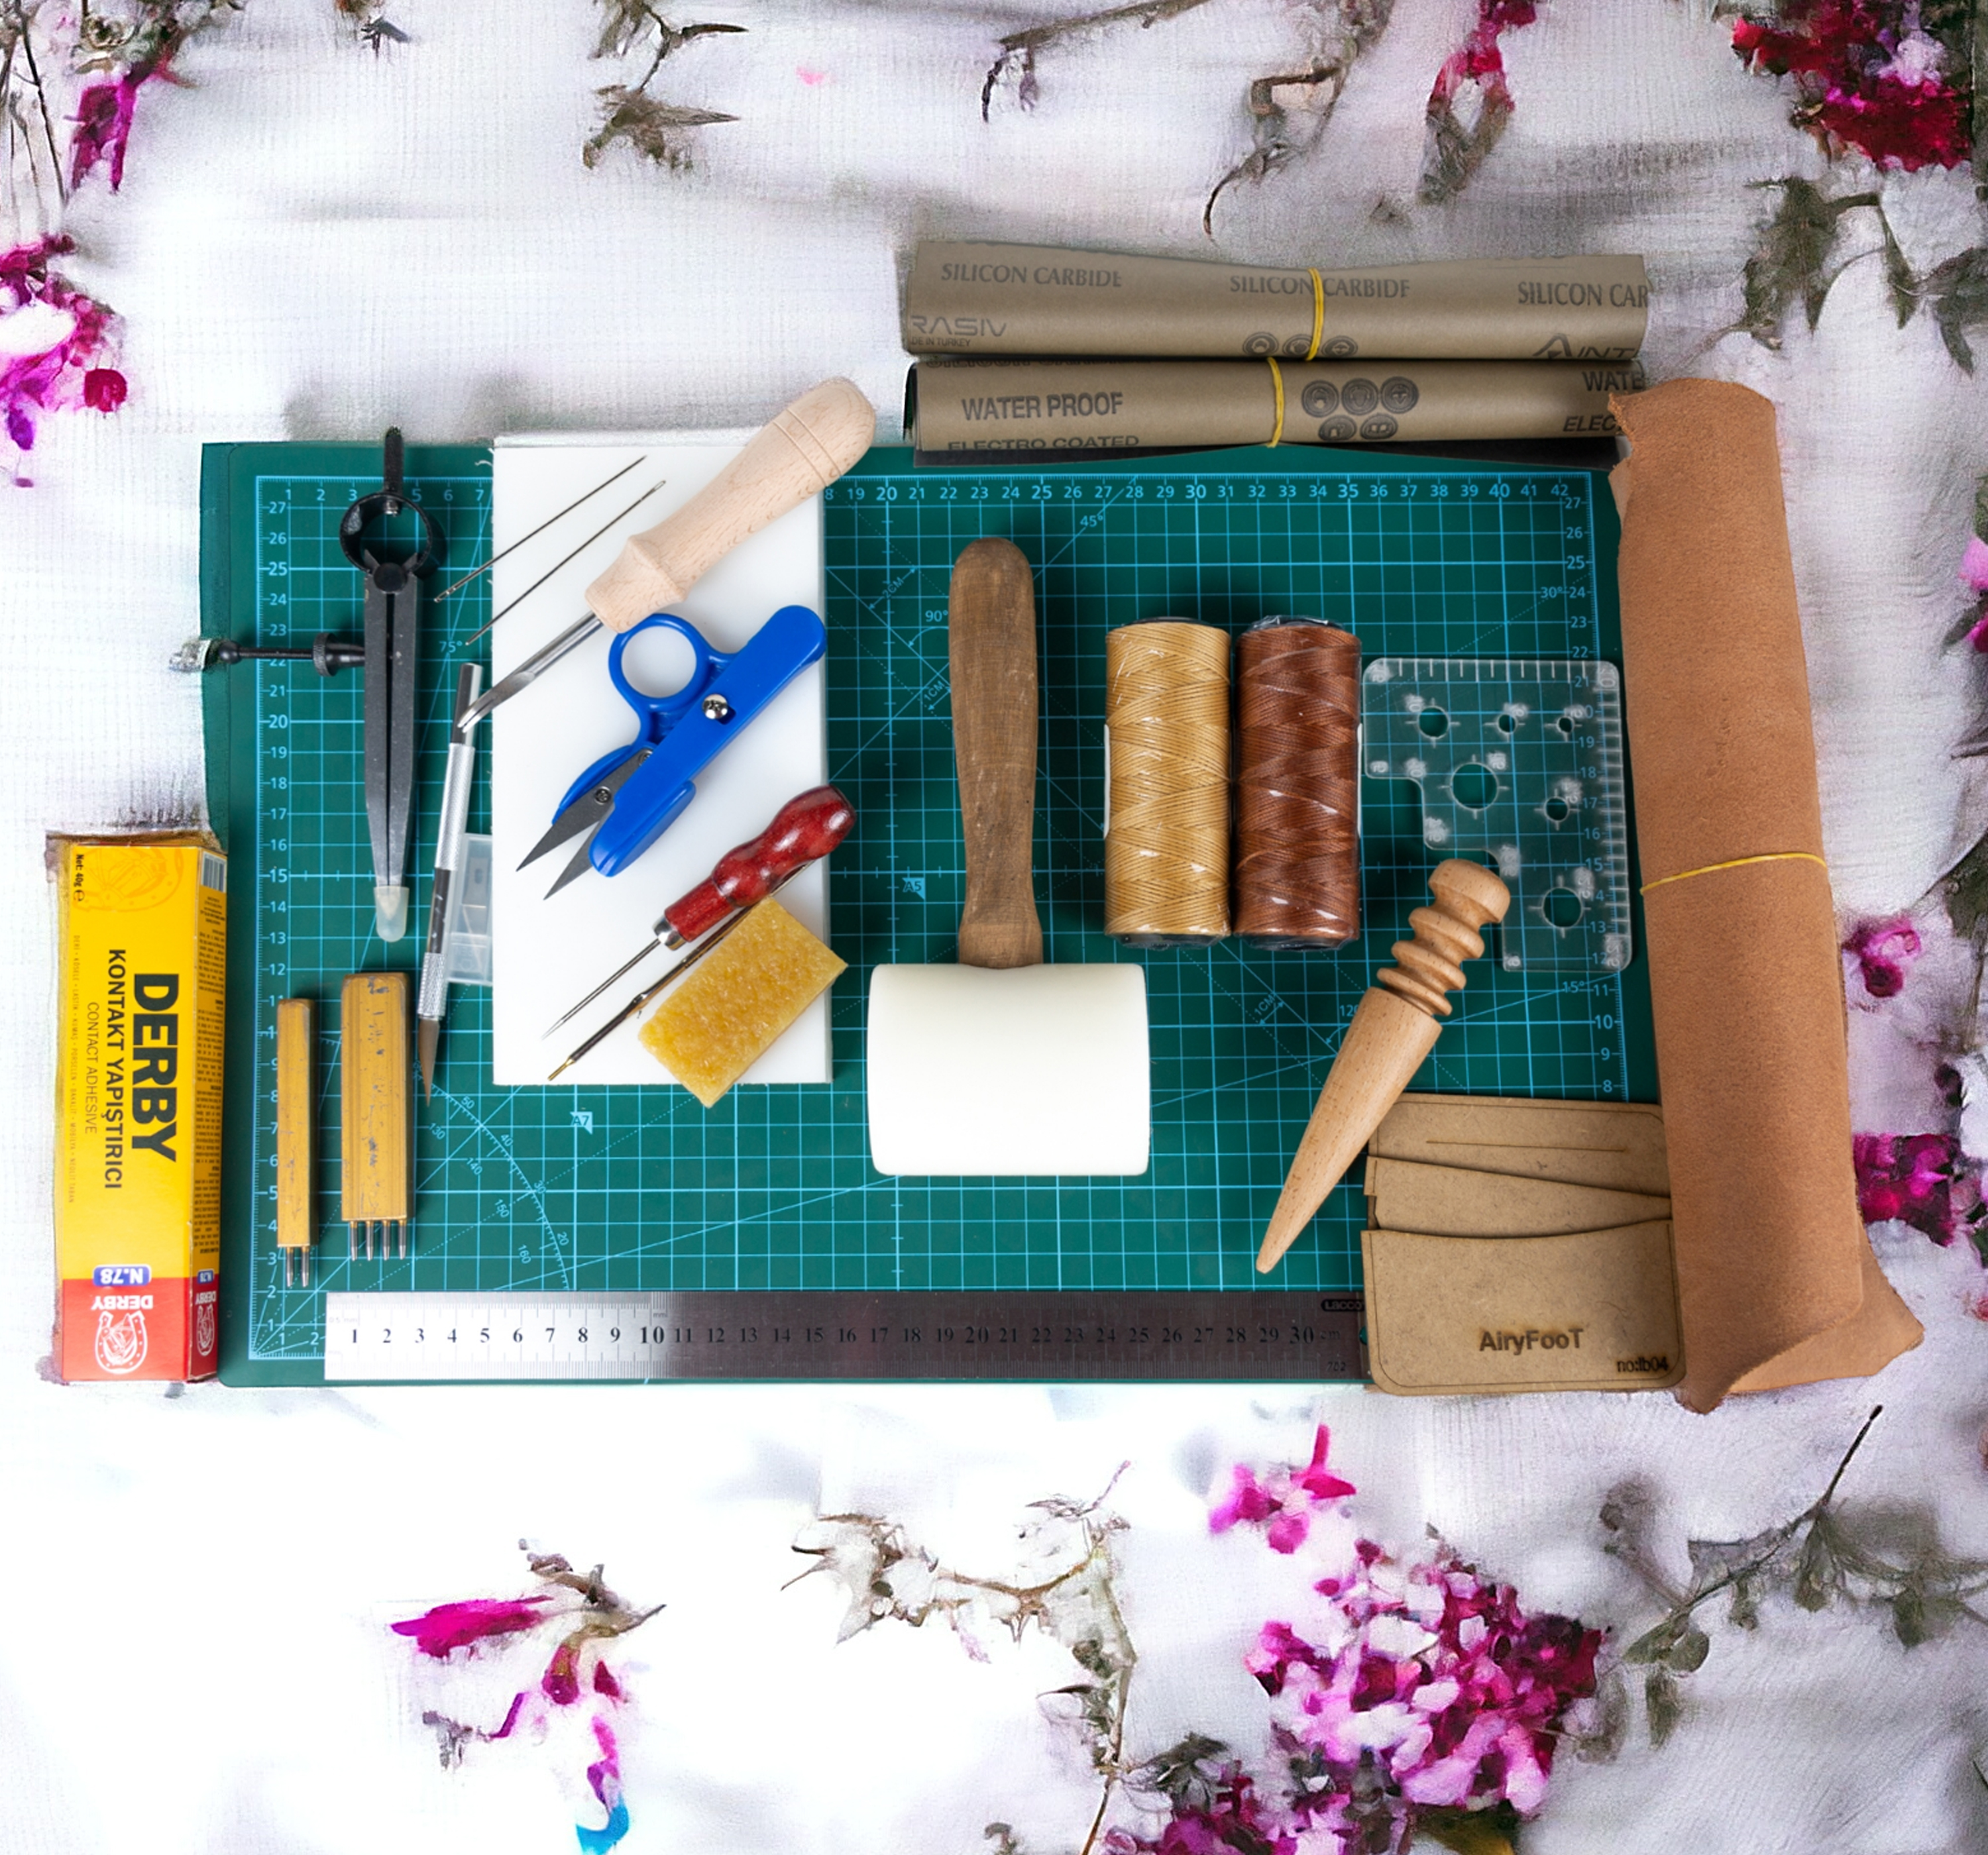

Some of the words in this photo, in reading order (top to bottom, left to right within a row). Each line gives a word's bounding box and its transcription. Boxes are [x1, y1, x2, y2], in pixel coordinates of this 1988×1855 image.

[941, 262, 1026, 284] SILICON
[1034, 266, 1122, 288] CARBIDE
[1230, 274, 1314, 295] SILICON
[1324, 276, 1410, 298] CARBIDE
[1518, 280, 1602, 307] SILICON
[937, 337, 971, 346] TURKEY
[961, 395, 1042, 421] WATER
[1046, 392, 1123, 417] PROOF
[1563, 413, 1620, 432] ELEC
[947, 438, 1046, 450] ELECTRO
[1052, 435, 1140, 449] COATED
[285, 489, 292, 500] 1
[317, 489, 325, 501] 2
[349, 489, 358, 501] 3
[412, 489, 421, 502] 5
[444, 489, 453, 502] 6
[476, 489, 484, 502] 7
[848, 488, 865, 500] 19
[876, 486, 898, 501] 20
[909, 487, 925, 500] 21
[940, 487, 958, 500] 22
[971, 486, 989, 499] 23
[1002, 486, 1020, 499] 24
[1032, 484, 1052, 500] 25
[1064, 486, 1082, 498] 26
[1095, 486, 1113, 498] 27
[1126, 486, 1144, 498] 28
[1156, 486, 1175, 498] 29
[1185, 484, 1207, 499] 30
[1217, 485, 1235, 498] 31
[1248, 485, 1266, 498] 32
[1278, 485, 1296, 498] 33
[1309, 485, 1327, 498] 34
[1338, 484, 1358, 498] 35
[1370, 485, 1388, 498] 36
[1400, 485, 1417, 498] 37
[1430, 485, 1449, 498] 38
[1461, 484, 1478, 497] 39
[1489, 483, 1510, 498] 40
[1520, 484, 1537, 497] 41
[1551, 484, 1569, 497] 42
[269, 502, 286, 514] 27
[1565, 497, 1581, 509] 27
[269, 532, 287, 545] 26
[1566, 527, 1583, 539] 26
[268, 562, 288, 576] 25
[1567, 555, 1585, 570] 25
[1569, 586, 1586, 599] 24
[269, 594, 287, 606] 24
[1571, 615, 1588, 628] 23
[269, 624, 287, 636] 23
[1572, 646, 1588, 659] 22
[1574, 676, 1589, 688] 21
[269, 684, 285, 697] 21
[268, 714, 288, 729] 20
[1579, 736, 1595, 748] 19
[270, 747, 288, 759] 19
[270, 777, 288, 789] 18
[270, 808, 287, 820] 17
[1584, 827, 1600, 839] 16
[270, 839, 287, 851] 16
[74, 873, 84, 888] 40g
[269, 869, 288, 883] 15
[903, 880, 922, 892] A5
[270, 901, 287, 913] 14
[269, 932, 286, 944] 13
[269, 963, 286, 976] 12
[1594, 984, 1608, 996] 11
[107, 949, 126, 1051] KONTAKT
[1595, 1014, 1613, 1030] 10
[85, 1002, 99, 1063] CONTACT
[1601, 1047, 1610, 1061] 9
[132, 973, 179, 1163] DERBY
[1602, 1080, 1612, 1093] 8
[84, 1065, 98, 1134] ADHESIVE
[460, 1096, 475, 1110] 50
[101, 1057, 124, 1189] YAPIŞTIRICI
[571, 1115, 590, 1126] A7
[429, 1122, 446, 1140] 130
[500, 1134, 514, 1147] 40
[466, 1158, 483, 1176] 140
[533, 1179, 547, 1194] 30
[494, 1198, 510, 1218] 150
[557, 1232, 569, 1246] 20
[268, 1252, 277, 1265] 3
[518, 1244, 531, 1264] 160
[100, 1268, 143, 1284] N.78
[195, 1291, 217, 1305] DERBY
[267, 1285, 276, 1298] 2
[91, 1295, 154, 1310] DERBY
[278, 1332, 285, 1346] 1
[310, 1332, 319, 1346] 2
[351, 1329, 358, 1344] 1
[382, 1329, 392, 1344] 2
[415, 1328, 425, 1344] 3
[447, 1328, 457, 1344] 4
[480, 1328, 490, 1343] 5
[513, 1328, 523, 1343] 6
[545, 1328, 555, 1343] 7
[579, 1328, 588, 1343] 8
[610, 1328, 621, 1343] 9
[639, 1326, 665, 1344] 10
[674, 1328, 692, 1344] 11
[707, 1328, 725, 1344] 12
[740, 1328, 758, 1344] 13
[773, 1328, 791, 1344] 14
[806, 1328, 824, 1344] 15
[839, 1328, 857, 1344] 16
[871, 1328, 889, 1344] 17
[903, 1328, 922, 1343] 18
[936, 1328, 954, 1343] 19
[965, 1326, 990, 1344] 20
[999, 1328, 1018, 1343] 21
[1031, 1327, 1052, 1343] 22
[1064, 1327, 1085, 1343] 23
[1096, 1327, 1117, 1343] 24
[1129, 1327, 1150, 1343] 25
[1162, 1327, 1183, 1343] 26
[1193, 1327, 1214, 1343] 27
[1226, 1327, 1246, 1344] 28
[1259, 1327, 1280, 1343] 29
[1290, 1326, 1314, 1344] 30
[1479, 1328, 1584, 1355] AiryFooT
